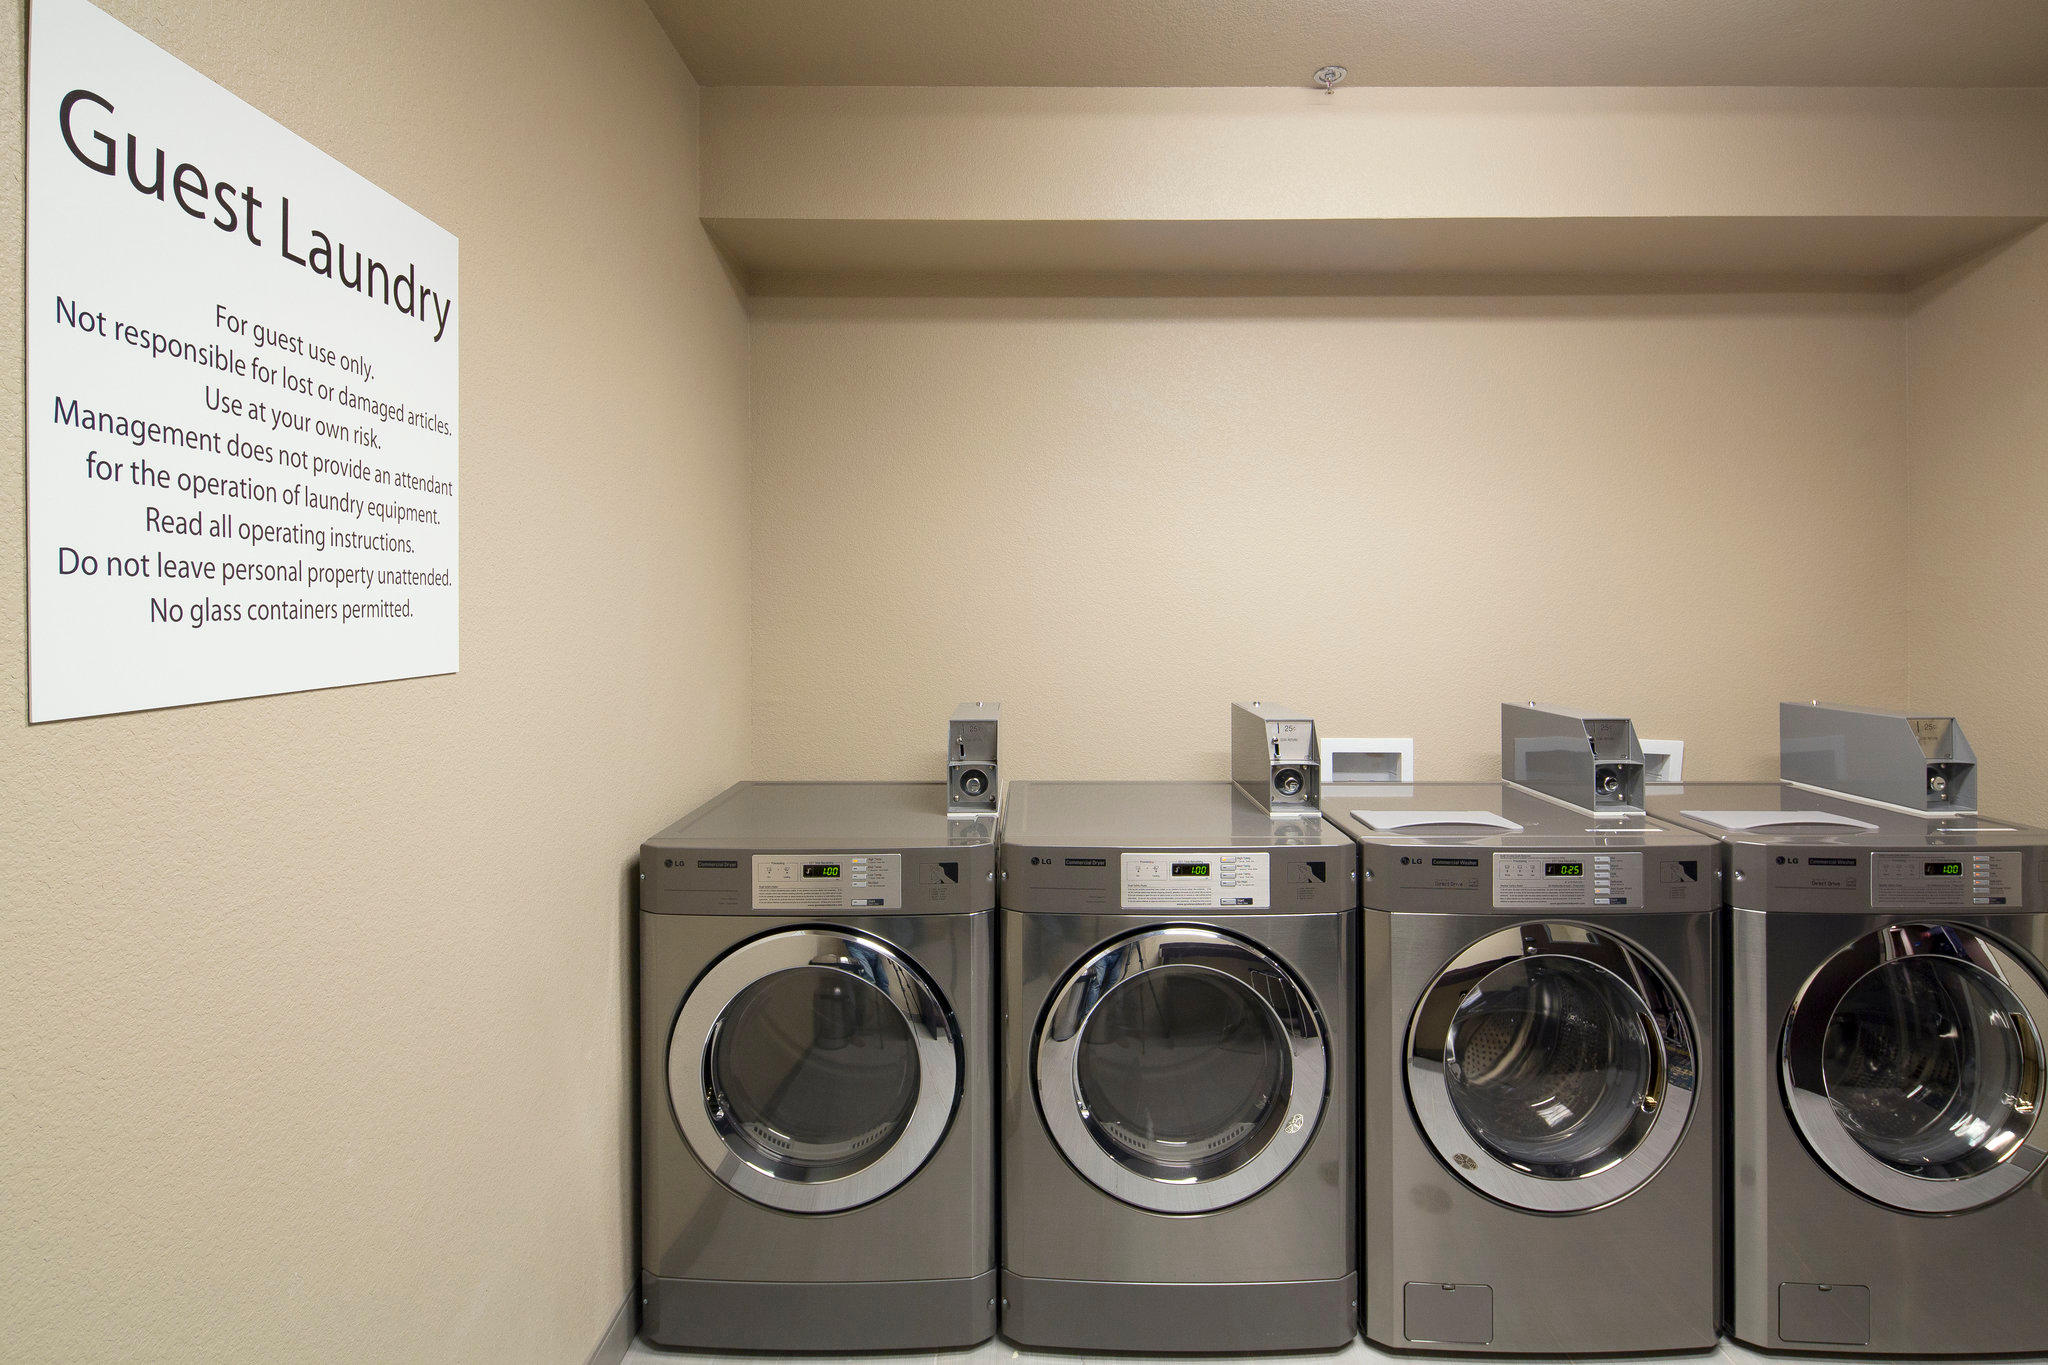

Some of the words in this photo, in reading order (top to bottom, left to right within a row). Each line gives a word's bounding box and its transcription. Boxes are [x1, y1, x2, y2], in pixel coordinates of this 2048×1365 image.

[60, 90, 262, 246] Guest
[282, 197, 451, 342] Laundry
[57, 296, 106, 336] Not
[115, 322, 246, 376] responsible
[252, 357, 277, 384] for
[283, 366, 313, 396] lost
[318, 385, 334, 401] or
[339, 386, 404, 422] damaged
[408, 411, 452, 436] articles.
[217, 305, 248, 335] For
[254, 325, 303, 356] guest
[309, 344, 335, 366] use
[341, 356, 375, 382] only.
[55, 396, 221, 453] Management
[228, 434, 273, 463] does
[280, 450, 308, 470] not
[314, 457, 370, 482] provide
[375, 469, 391, 484] an
[395, 472, 453, 496] attendant
[206, 386, 243, 416] Use
[249, 403, 266, 422] at
[272, 409, 311, 431] your
[316, 421, 348, 441] own
[354, 428, 381, 449] risk.
[86, 451, 123, 481] for
[130, 460, 170, 488] the
[178, 473, 277, 502] operation
[282, 484, 300, 505] of
[305, 486, 364, 519] laundry
[368, 501, 440, 525] equipment.
[147, 507, 202, 536] Read
[210, 514, 232, 538] all
[239, 522, 325, 551] operating
[330, 527, 414, 553] instructions.
[60, 548, 98, 575] Do
[107, 555, 150, 578] not
[158, 552, 215, 579] leave
[222, 560, 301, 585] personal
[308, 566, 374, 589] property
[378, 569, 452, 587] unattended.
[151, 598, 183, 622] No
[190, 597, 242, 628] glass
[248, 599, 338, 620] containers
[343, 599, 413, 623] permitted.
